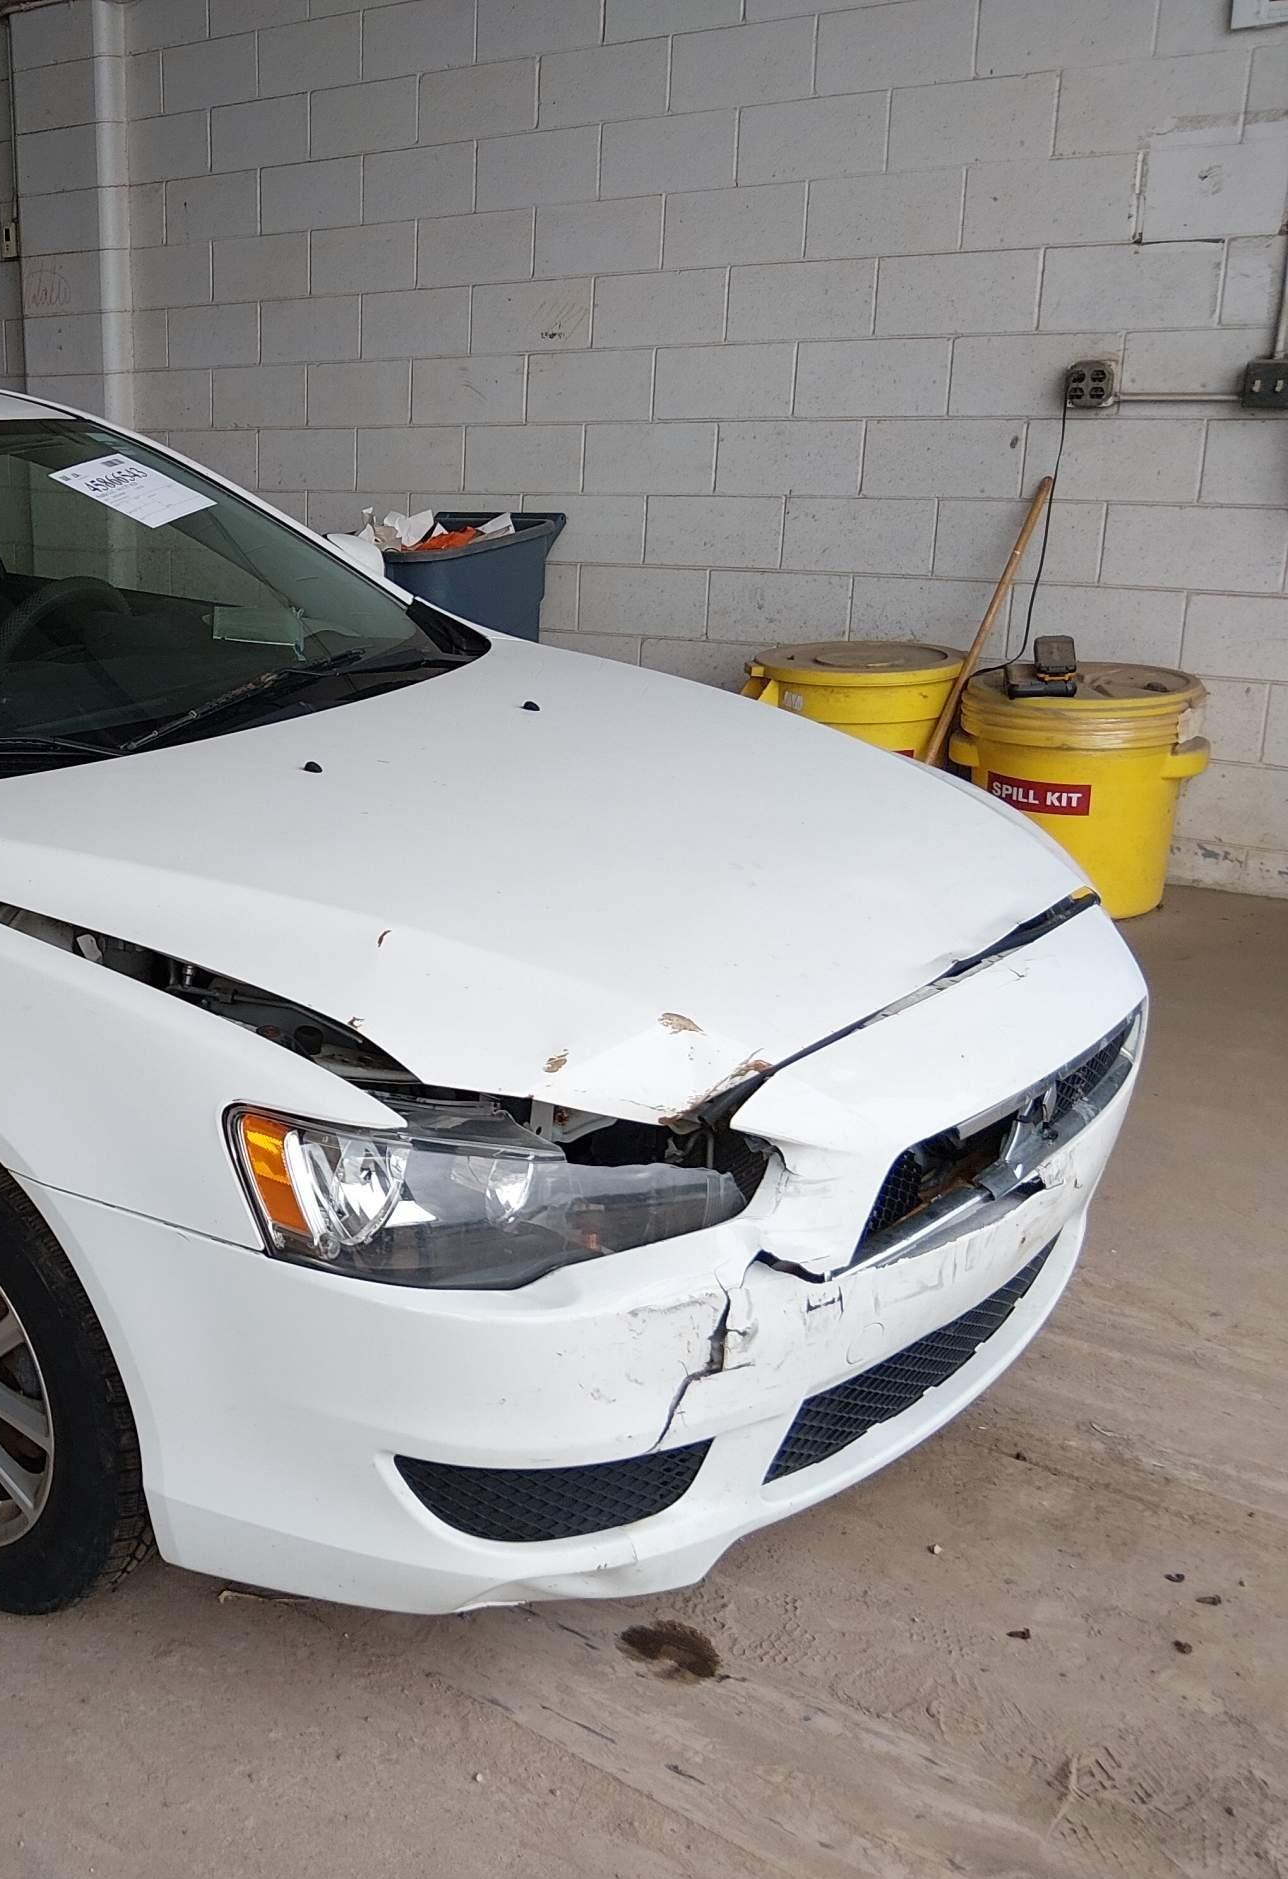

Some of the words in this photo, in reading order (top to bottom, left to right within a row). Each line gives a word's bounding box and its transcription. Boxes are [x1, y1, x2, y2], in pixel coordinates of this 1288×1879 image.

[84, 467, 148, 493] 45866543
[992, 781, 1040, 804] SPILL
[1045, 791, 1083, 808] KIT
